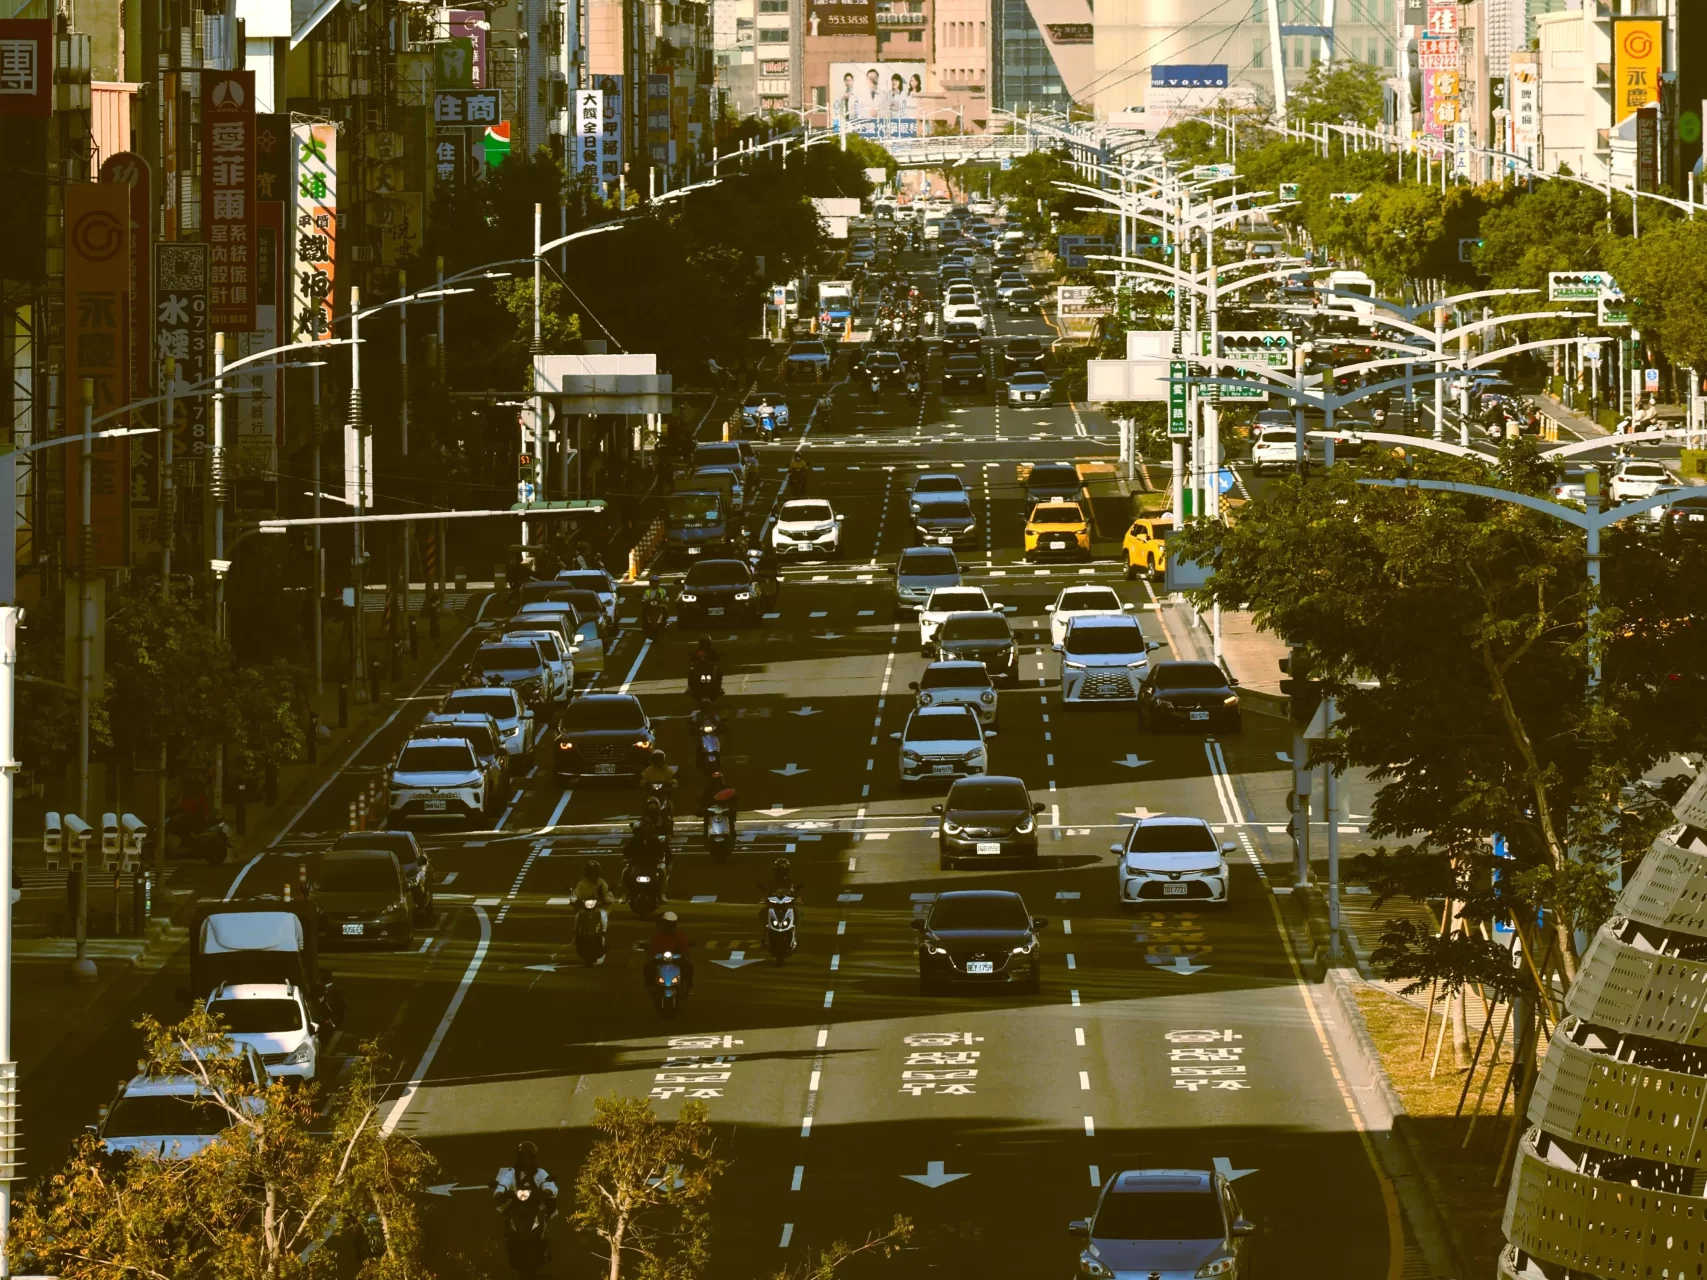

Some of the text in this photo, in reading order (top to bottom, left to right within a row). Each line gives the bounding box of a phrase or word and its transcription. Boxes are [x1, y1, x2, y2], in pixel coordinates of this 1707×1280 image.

[434, 94, 496, 122] 住商
[1626, 67, 1647, 112] 永慶
[212, 121, 245, 220] 愛菲爾
